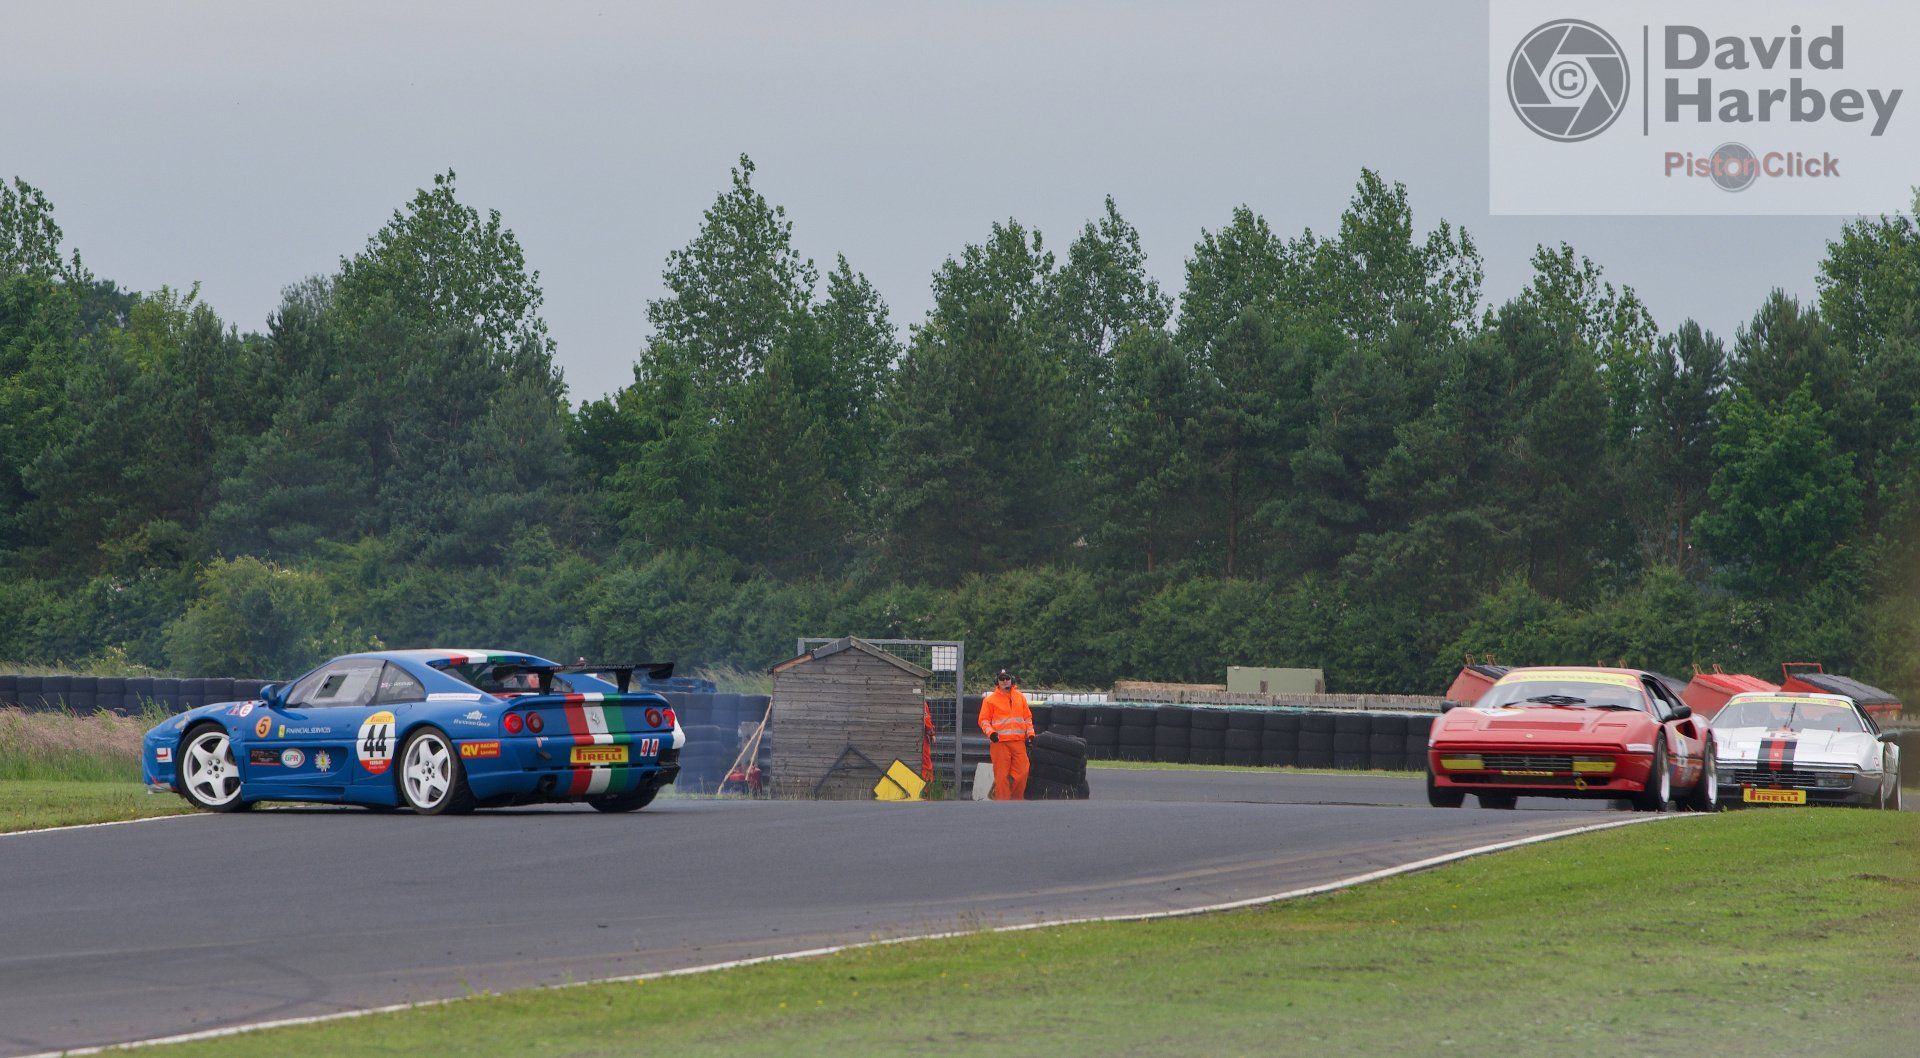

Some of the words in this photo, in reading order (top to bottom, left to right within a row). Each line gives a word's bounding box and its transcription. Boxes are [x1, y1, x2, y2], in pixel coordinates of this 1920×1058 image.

[258, 719, 270, 735] 5
[363, 725, 387, 757] 44
[461, 744, 479, 757] QV
[576, 747, 622, 761] PIRELLI
[640, 740, 658, 757] 44
[284, 753, 299, 762] GPR
[1750, 788, 1799, 802] PIRELLI
